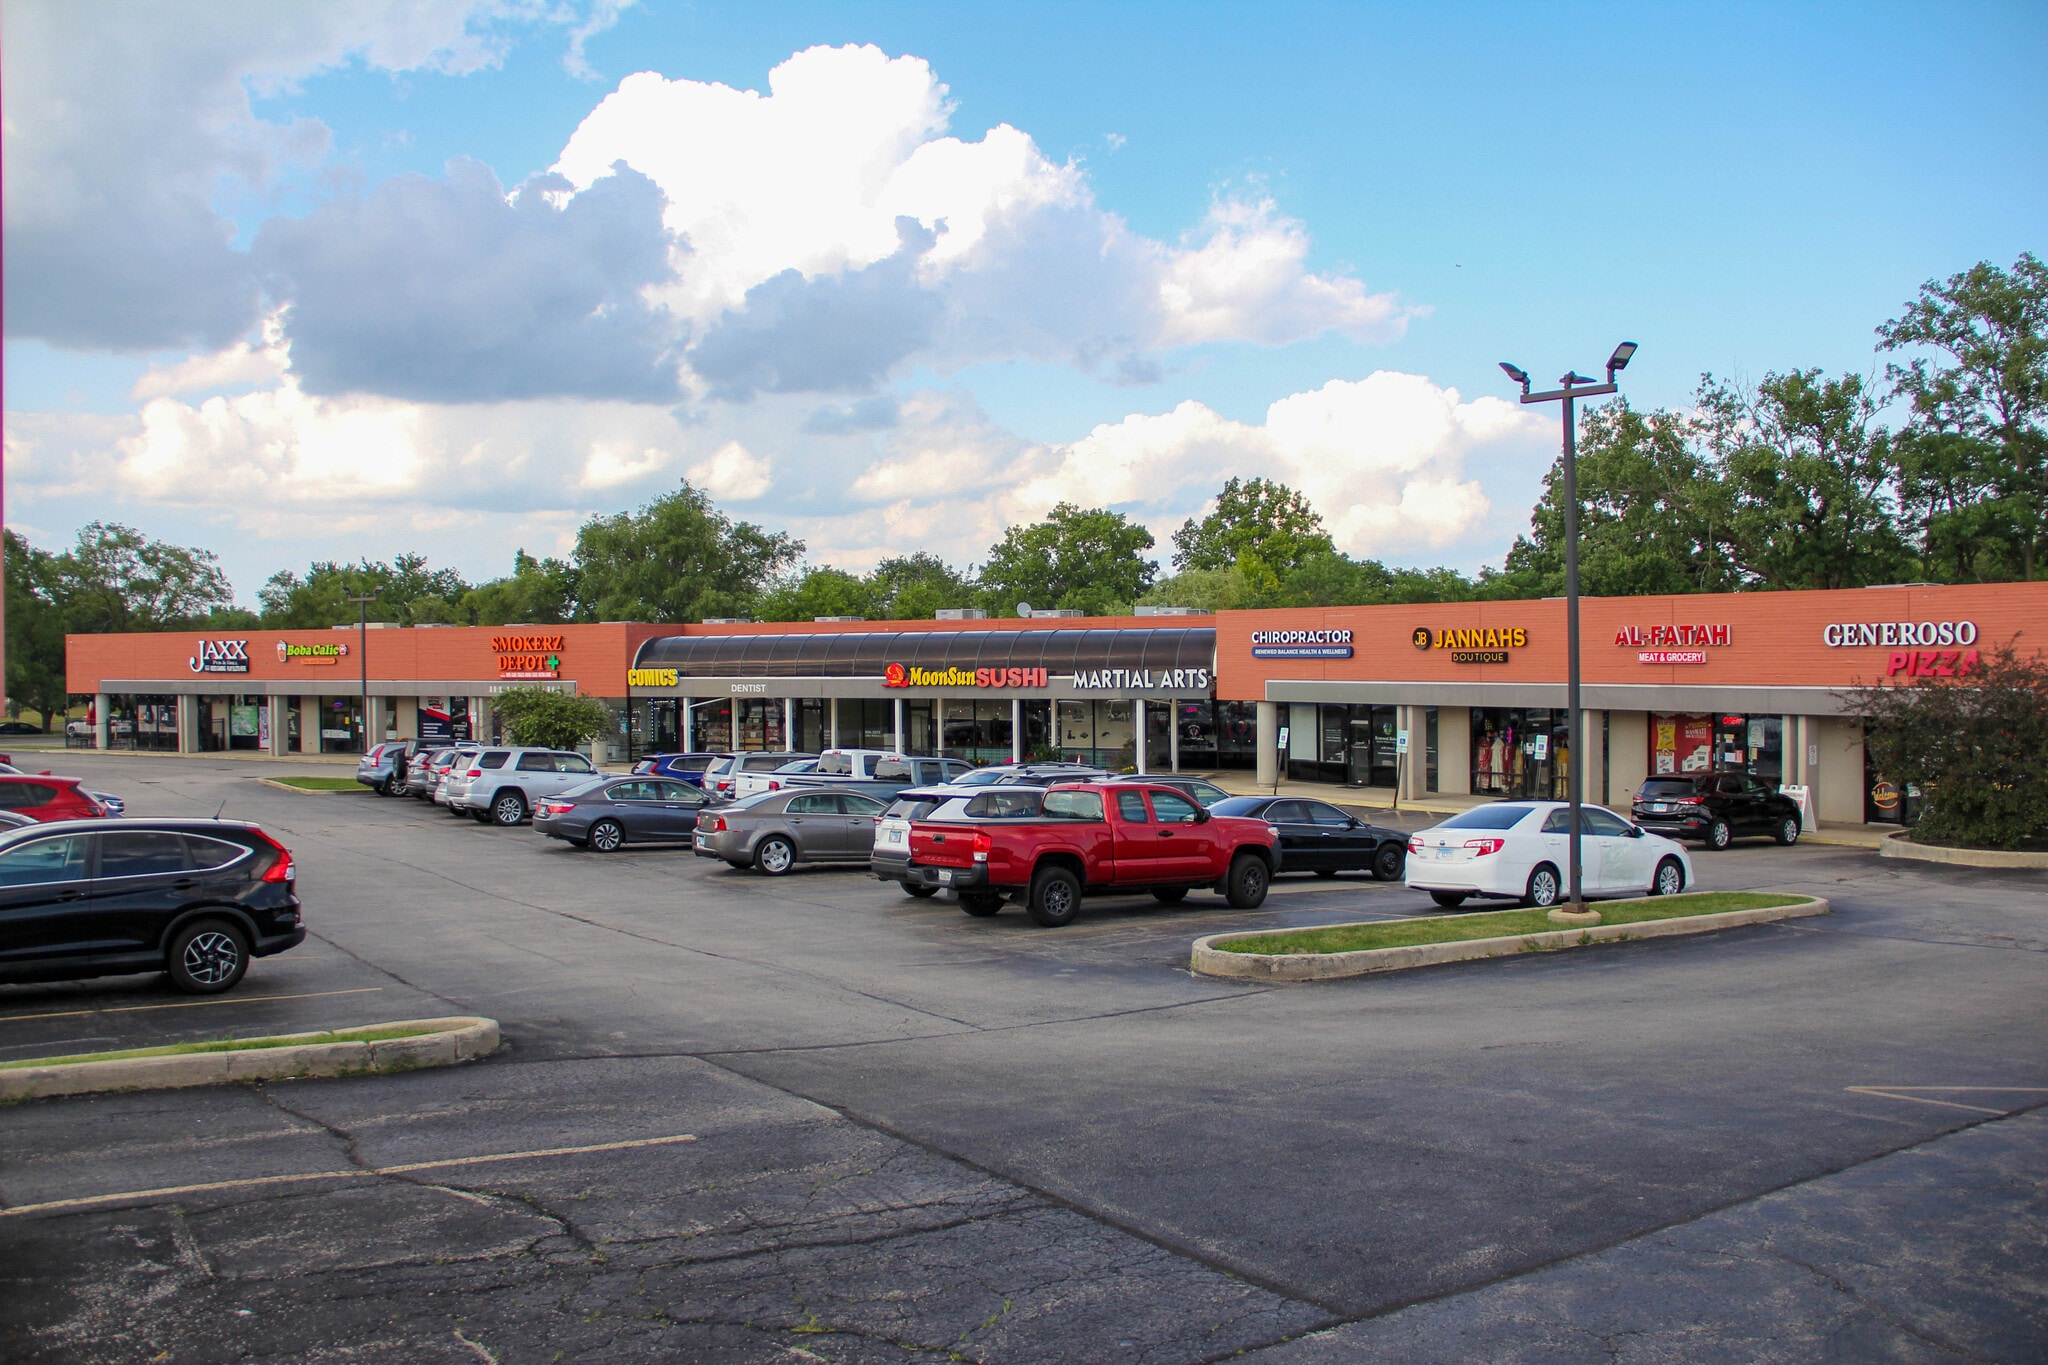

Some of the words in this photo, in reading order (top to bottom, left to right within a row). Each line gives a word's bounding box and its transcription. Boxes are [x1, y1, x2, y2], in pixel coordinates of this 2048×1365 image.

[1251, 629, 1352, 644] CHIROPRACTOR
[1414, 631, 1427, 645] JB
[1433, 627, 1527, 648] JANNAHS
[1614, 624, 1731, 646] AL-FATAH
[1823, 621, 1978, 647] GENEROSO
[287, 644, 312, 656] Boba
[491, 636, 564, 651] SMOKERZ
[190, 640, 248, 673] JAXX
[498, 655, 546, 671] DEPOT
[1452, 652, 1504, 663] BOUTIQUE
[1639, 652, 1659, 662] MEAT
[1660, 652, 1665, 662] &
[1666, 652, 1703, 662] GROCERY
[1887, 651, 1980, 677] PIZZA
[628, 668, 679, 688] COMICS
[909, 666, 976, 687] MoonSun
[976, 667, 1048, 688] SUSHI
[1073, 669, 1154, 689] MARTIAL
[1160, 668, 1209, 689] ARTS
[731, 684, 766, 693] DENTIST
